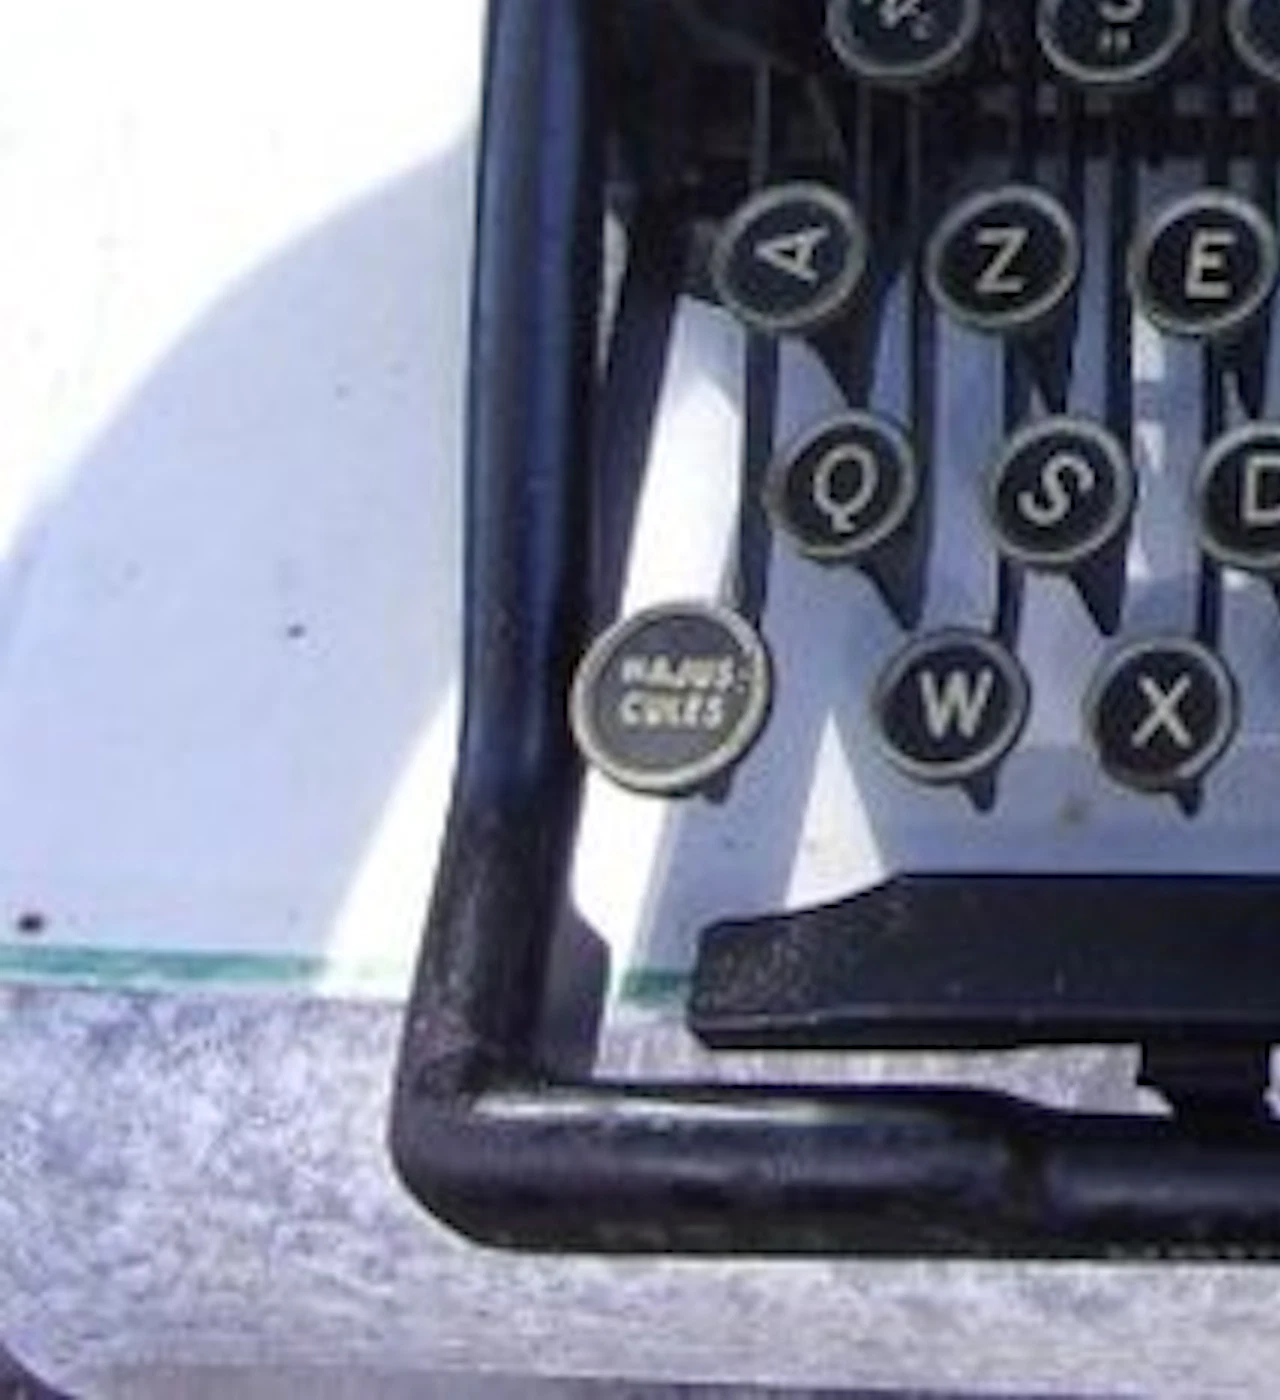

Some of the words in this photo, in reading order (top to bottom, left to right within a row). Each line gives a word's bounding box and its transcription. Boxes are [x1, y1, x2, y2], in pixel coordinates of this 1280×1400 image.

[755, 226, 826, 281] A
[977, 227, 1026, 293] Z
[1184, 232, 1237, 299] E
[812, 444, 876, 534] Q
[1018, 453, 1094, 527] S
[918, 670, 992, 739] W
[1132, 673, 1193, 749] X
